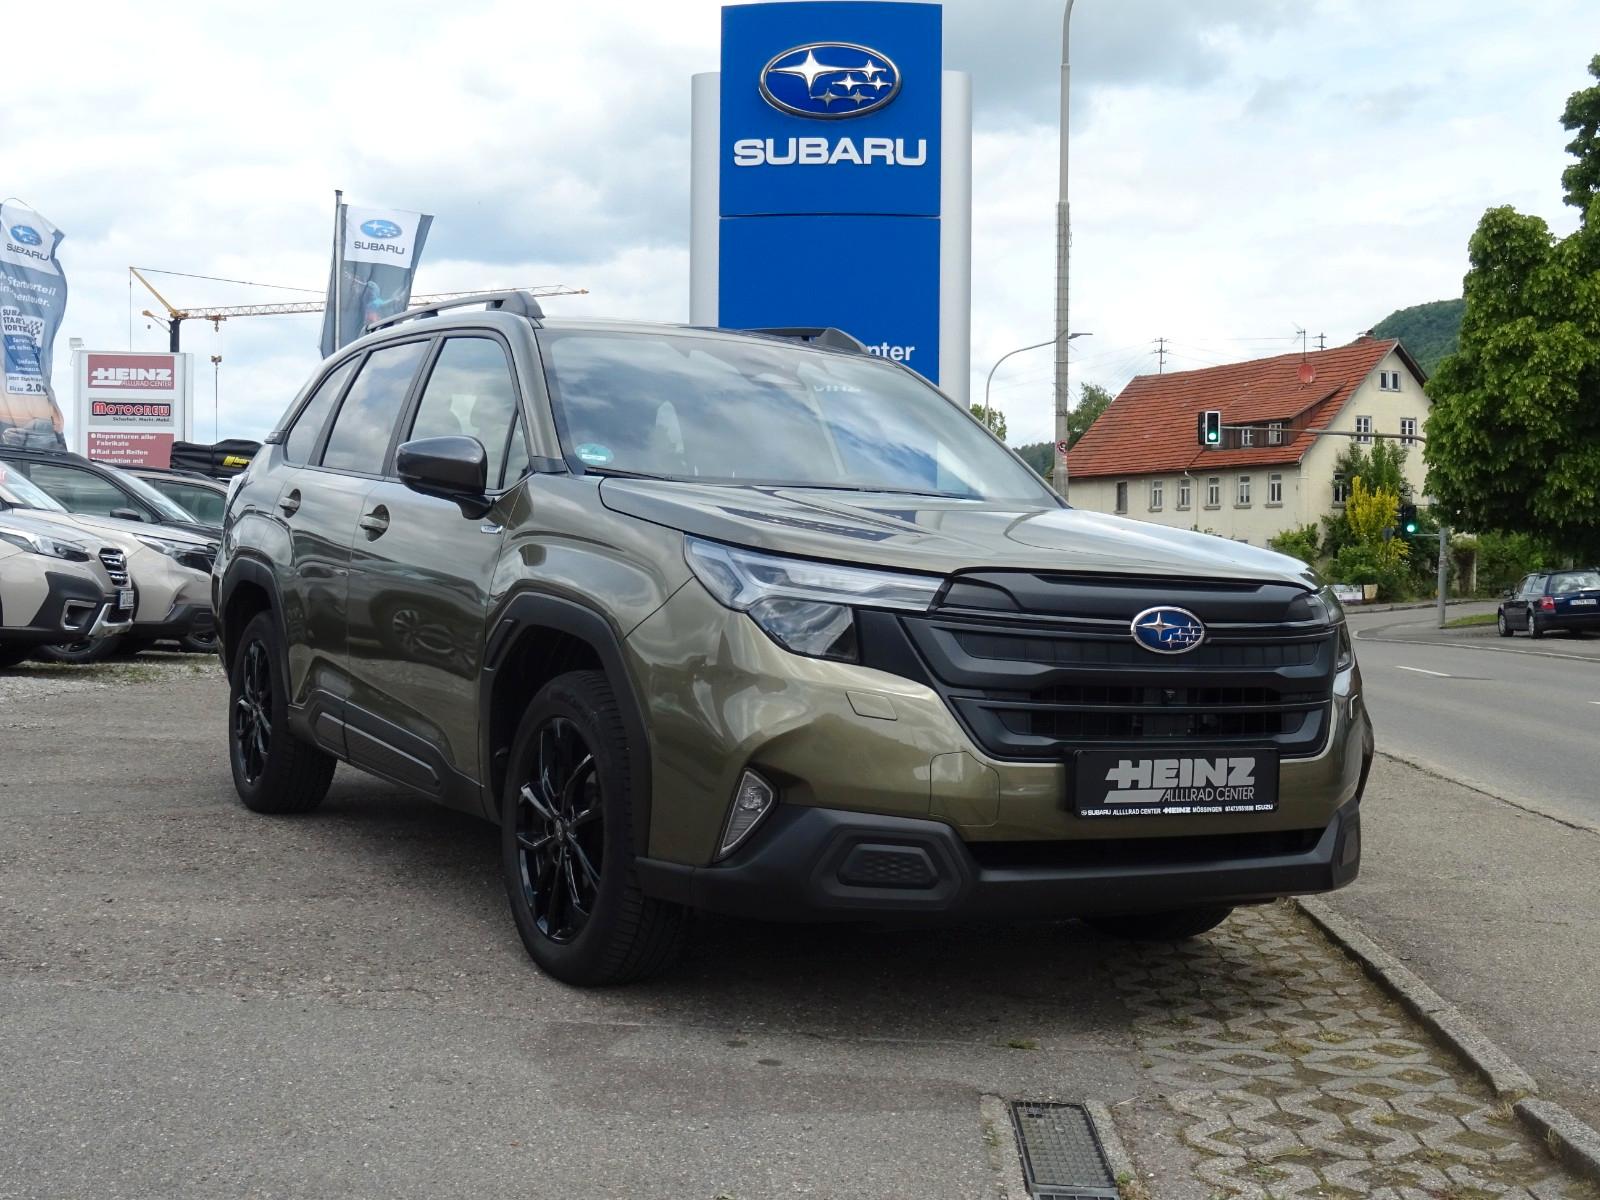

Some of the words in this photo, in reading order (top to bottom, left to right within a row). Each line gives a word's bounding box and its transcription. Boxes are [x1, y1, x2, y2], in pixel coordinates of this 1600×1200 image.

[733, 137, 927, 166] SUBARU
[6, 243, 50, 261] SUBARU
[354, 241, 405, 255] SUBARU
[866, 341, 916, 361] nter
[91, 367, 172, 381] HEINZ
[150, 380, 172, 388] CENTER
[96, 433, 139, 441] Reparaturen
[1104, 757, 1256, 789] HEINZ
[1161, 788, 1214, 803] ALLLLRAD
[1216, 786, 1255, 801] CENTER
[1087, 808, 1112, 816] SUBARU
[1140, 807, 1162, 815] CENTER
[1162, 806, 1191, 814] HEINZ
[1255, 803, 1273, 811] ISUZU
